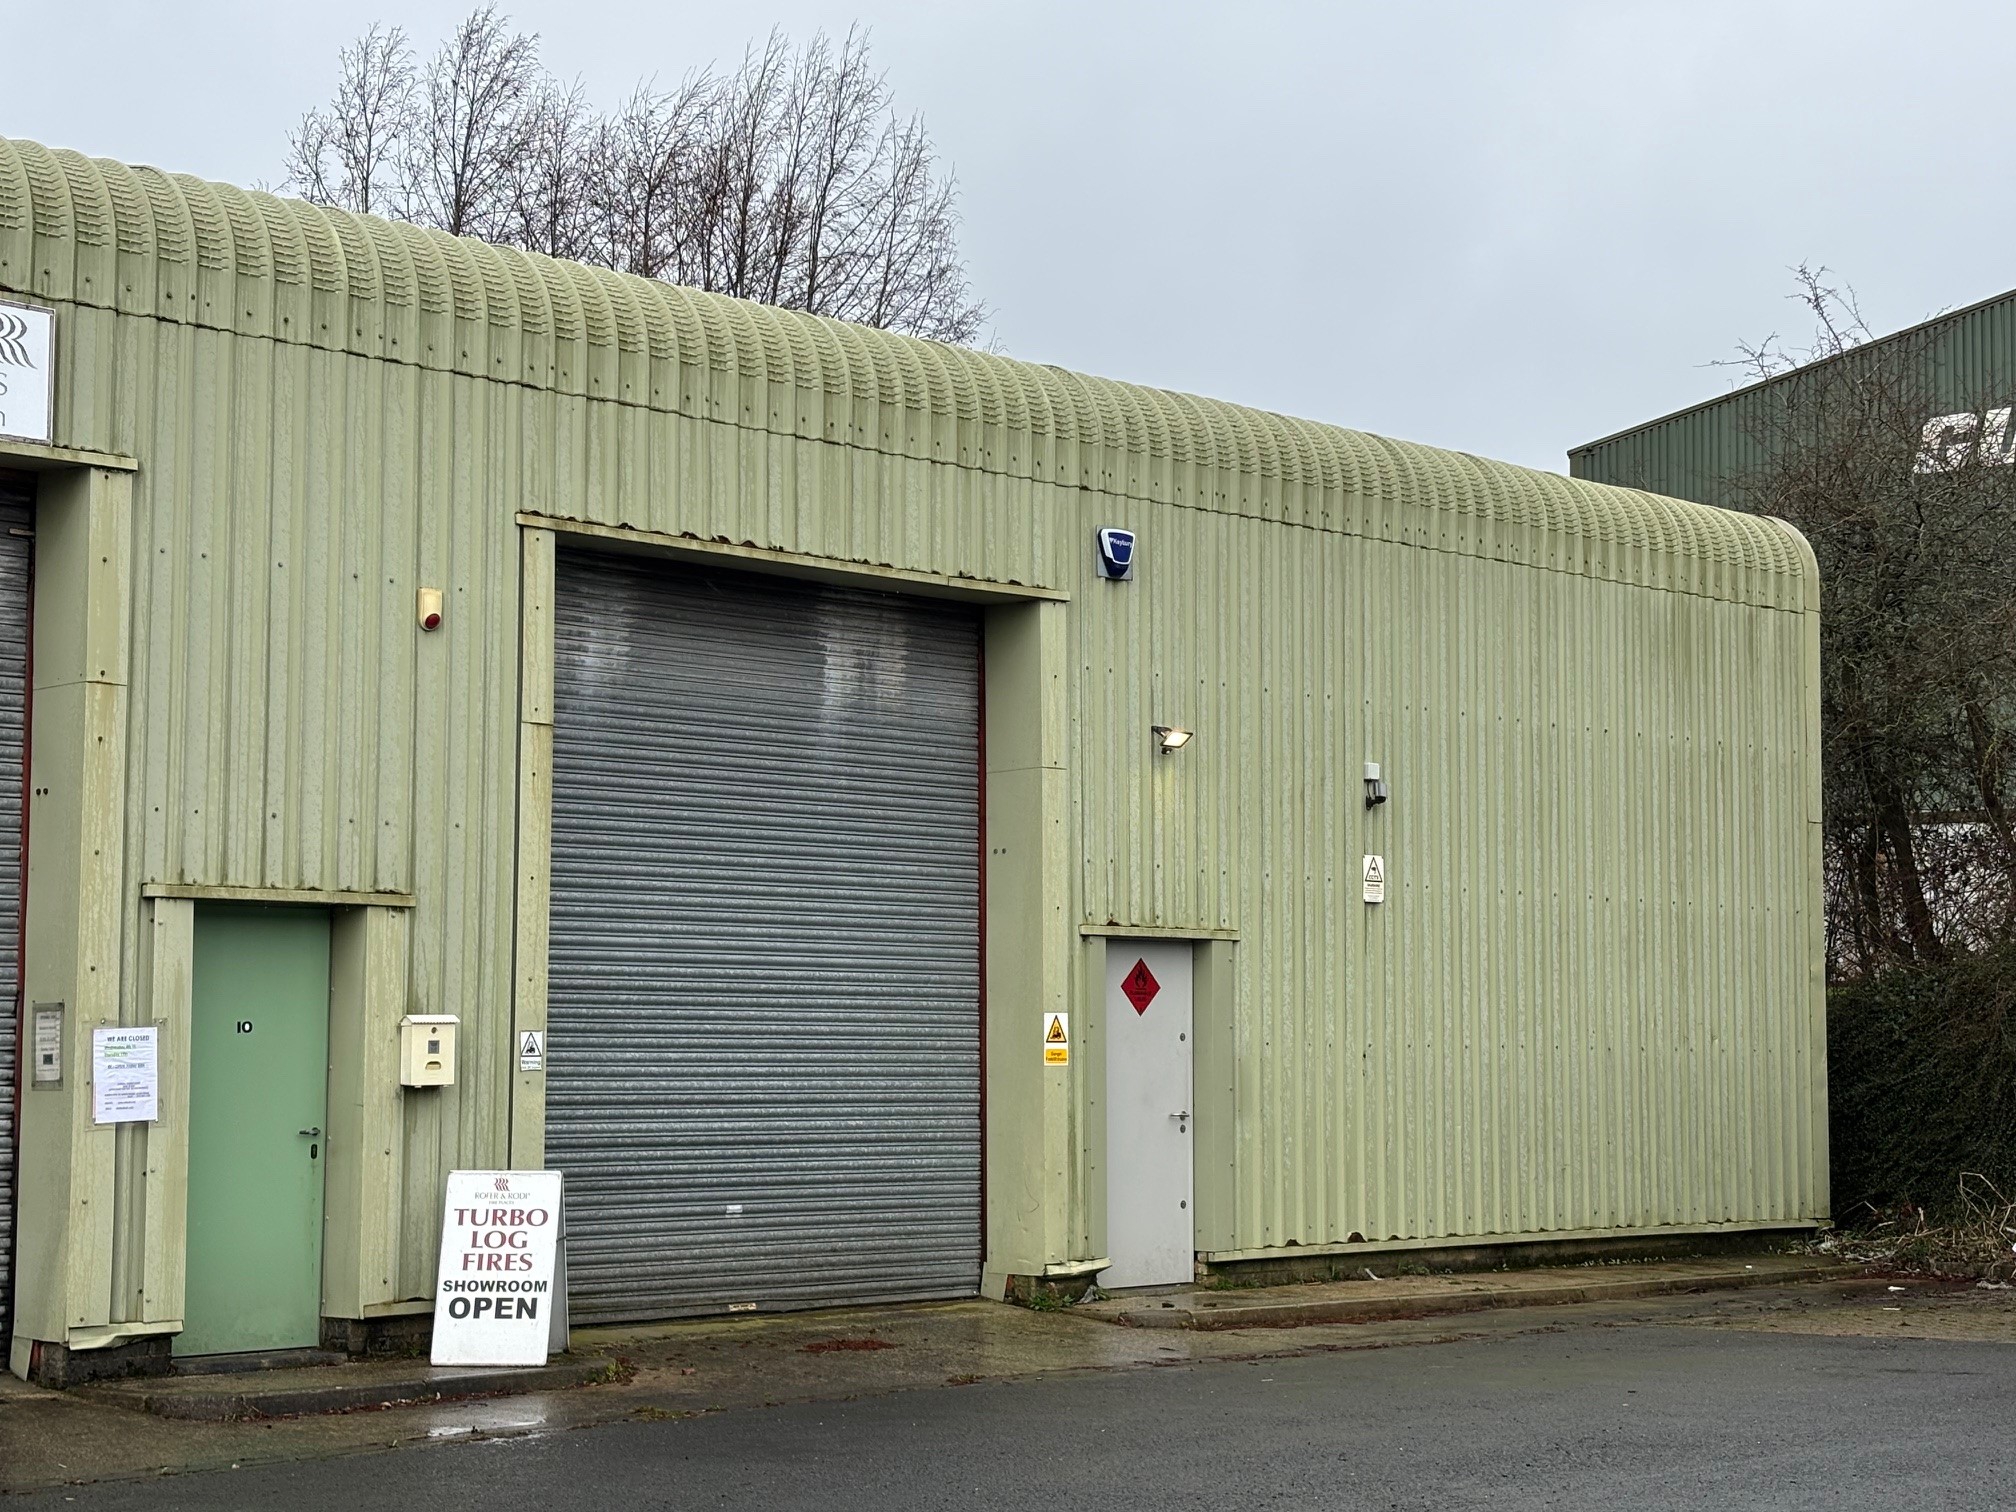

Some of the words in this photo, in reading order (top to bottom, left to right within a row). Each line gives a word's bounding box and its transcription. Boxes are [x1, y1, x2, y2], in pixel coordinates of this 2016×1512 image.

[237, 1021, 253, 1034] 10
[500, 1192, 507, 1200] &
[454, 1208, 549, 1227] TURBO
[471, 1230, 528, 1249] LOG
[462, 1253, 533, 1272] FIRES
[442, 1279, 548, 1293] SHOWROOM
[448, 1296, 538, 1320] OPEN
